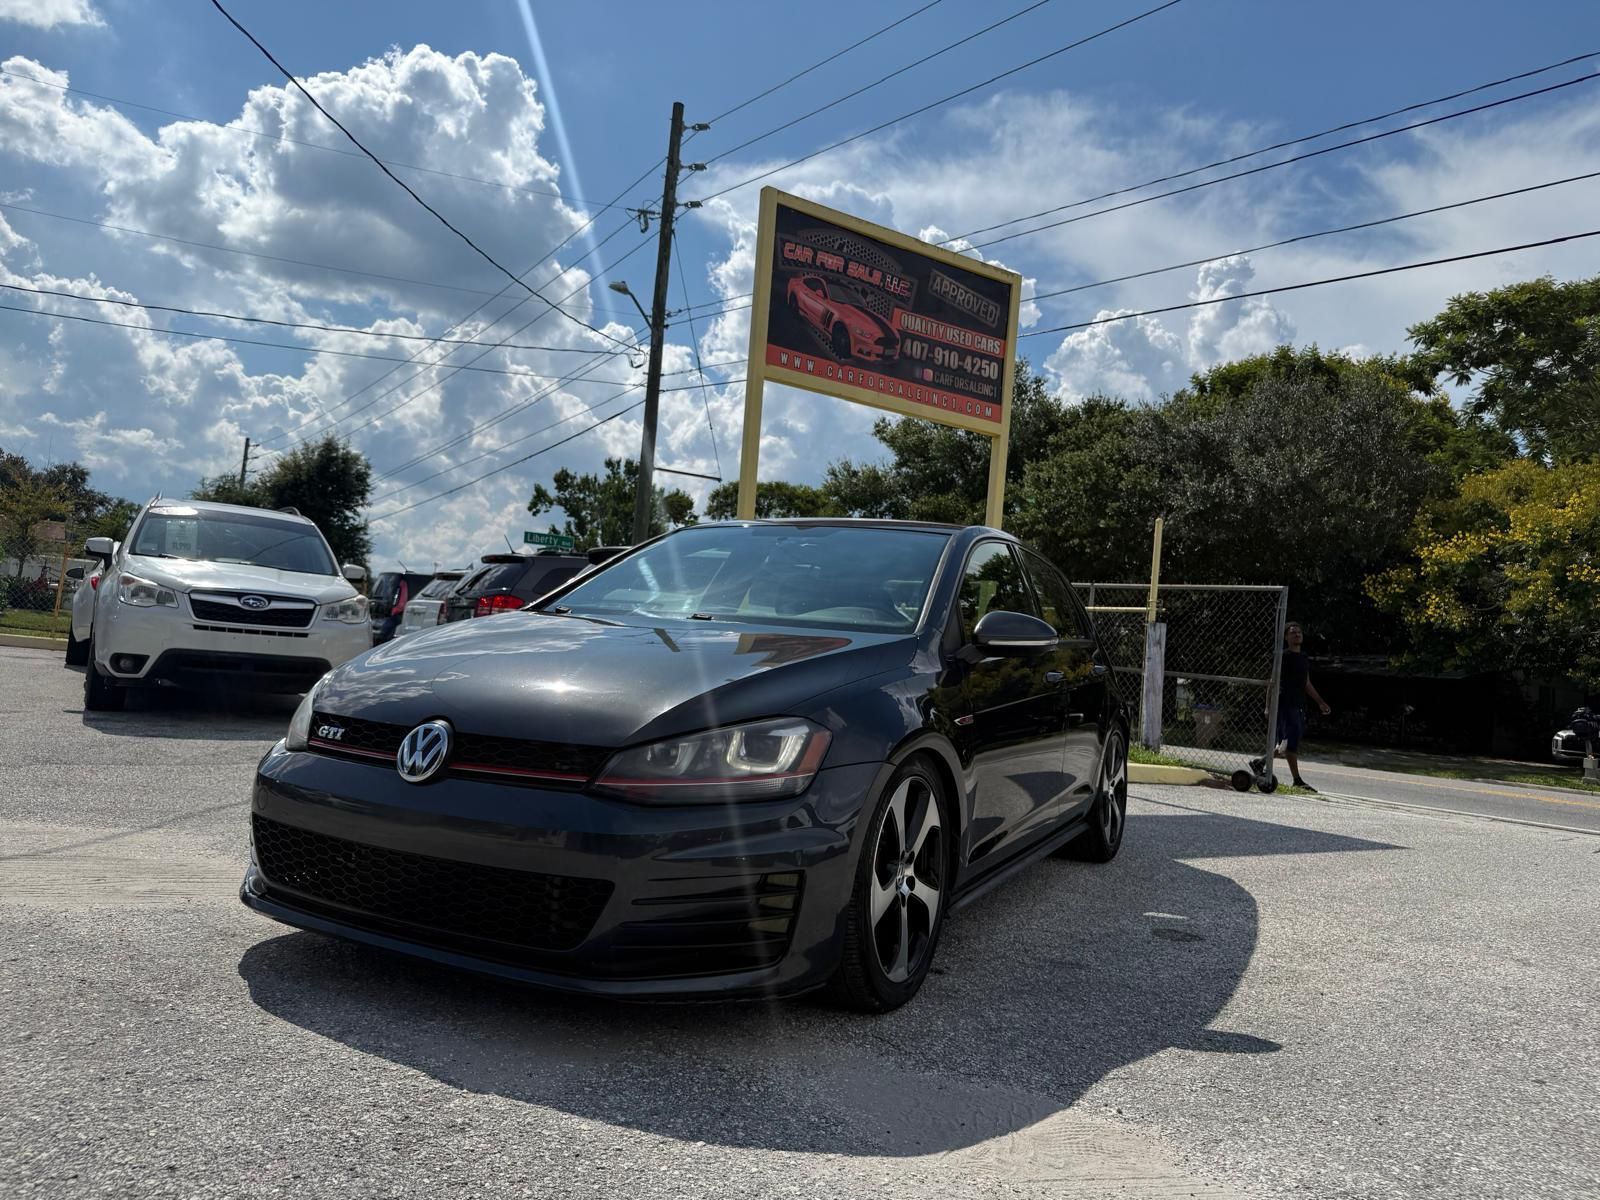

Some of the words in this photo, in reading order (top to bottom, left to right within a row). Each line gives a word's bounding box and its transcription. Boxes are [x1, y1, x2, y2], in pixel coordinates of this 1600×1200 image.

[784, 242, 814, 264] CAR
[816, 251, 845, 272] FOR
[885, 274, 913, 297] LLC
[932, 276, 997, 322] APPROVED
[901, 313, 944, 337] QUALITY
[946, 327, 972, 346] USED
[974, 335, 1001, 354] CARS
[902, 338, 999, 380] 407-910-4250
[527, 532, 559, 546] Liberty
[318, 725, 345, 740] GTI
